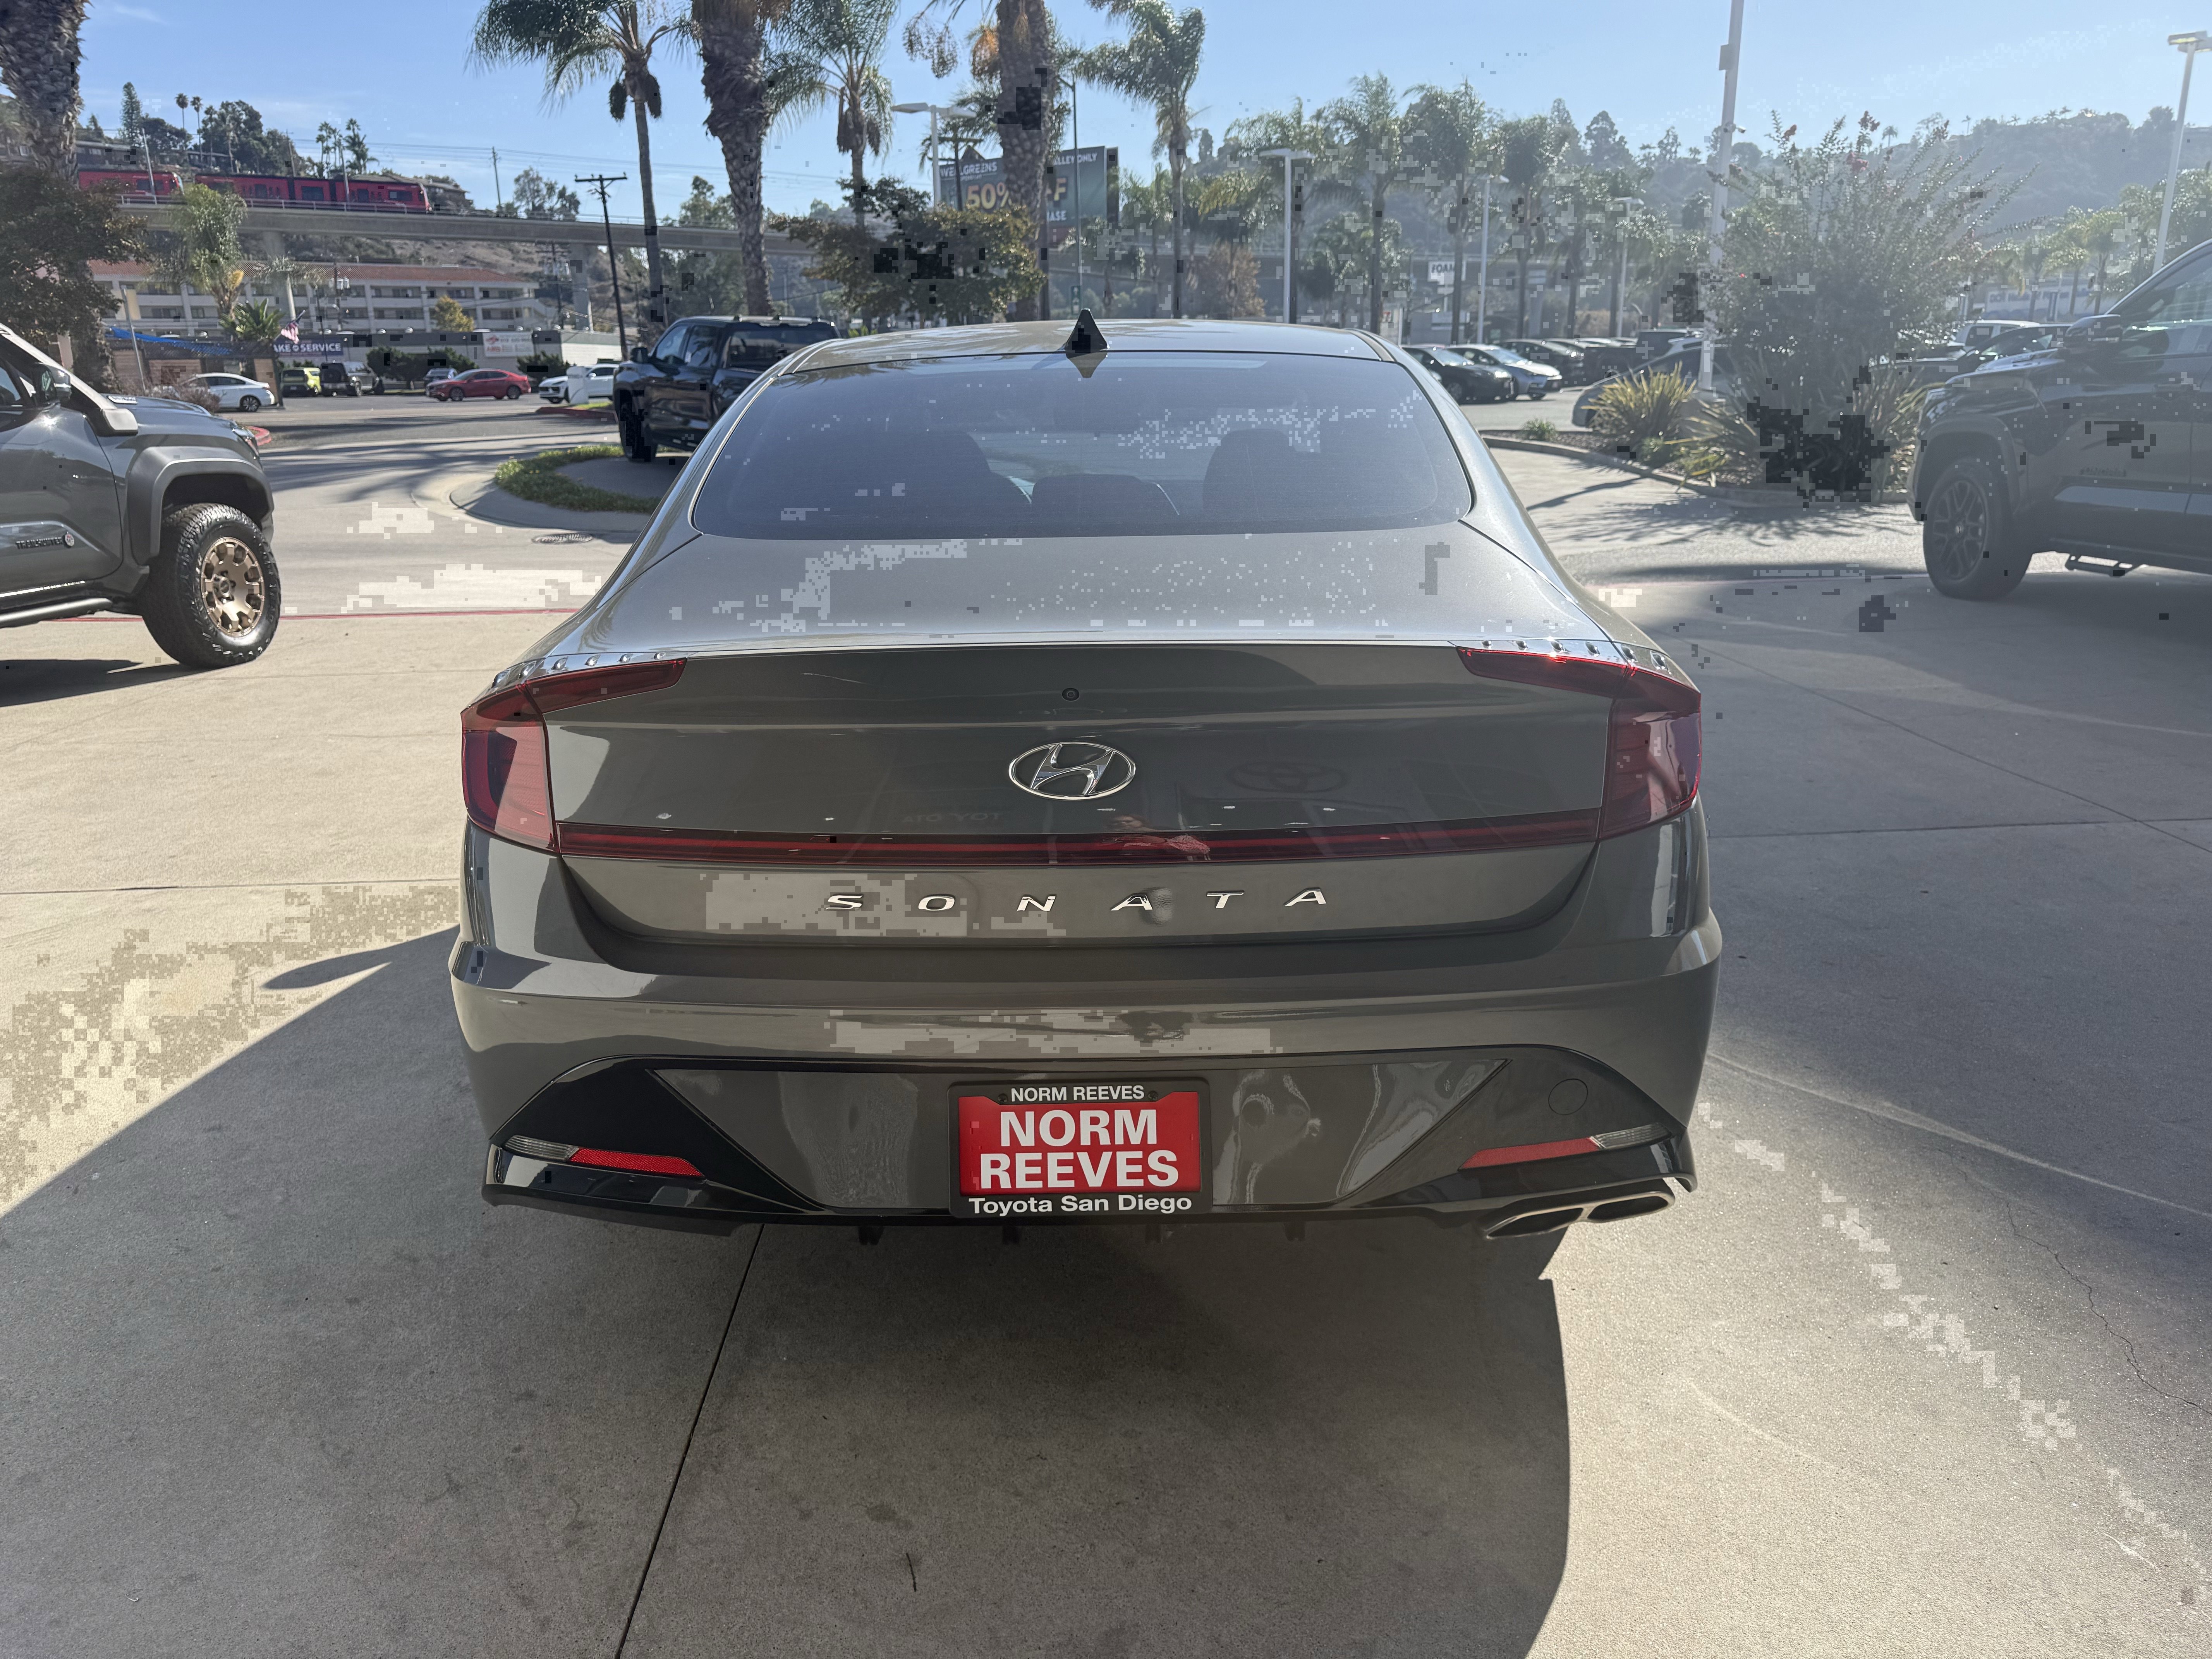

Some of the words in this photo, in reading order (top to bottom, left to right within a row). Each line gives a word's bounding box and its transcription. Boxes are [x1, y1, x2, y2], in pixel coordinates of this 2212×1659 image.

[941, 161, 998, 177] WELGREENS
[1053, 155, 1075, 165] ALLEY
[1077, 153, 1097, 163] ONLY
[966, 182, 1012, 210] 50%
[273, 343, 291, 353] AKE
[300, 343, 341, 352] SERVICE
[826, 888, 1326, 911] SONATA
[1011, 1087, 1067, 1102] NORM
[1073, 1085, 1144, 1100] REEVES
[1001, 1109, 1157, 1147] NORM
[981, 1150, 1178, 1189] REEVES
[969, 1197, 1052, 1216] Toyota
[1061, 1195, 1109, 1212] San
[1118, 1194, 1192, 1214] Diego
